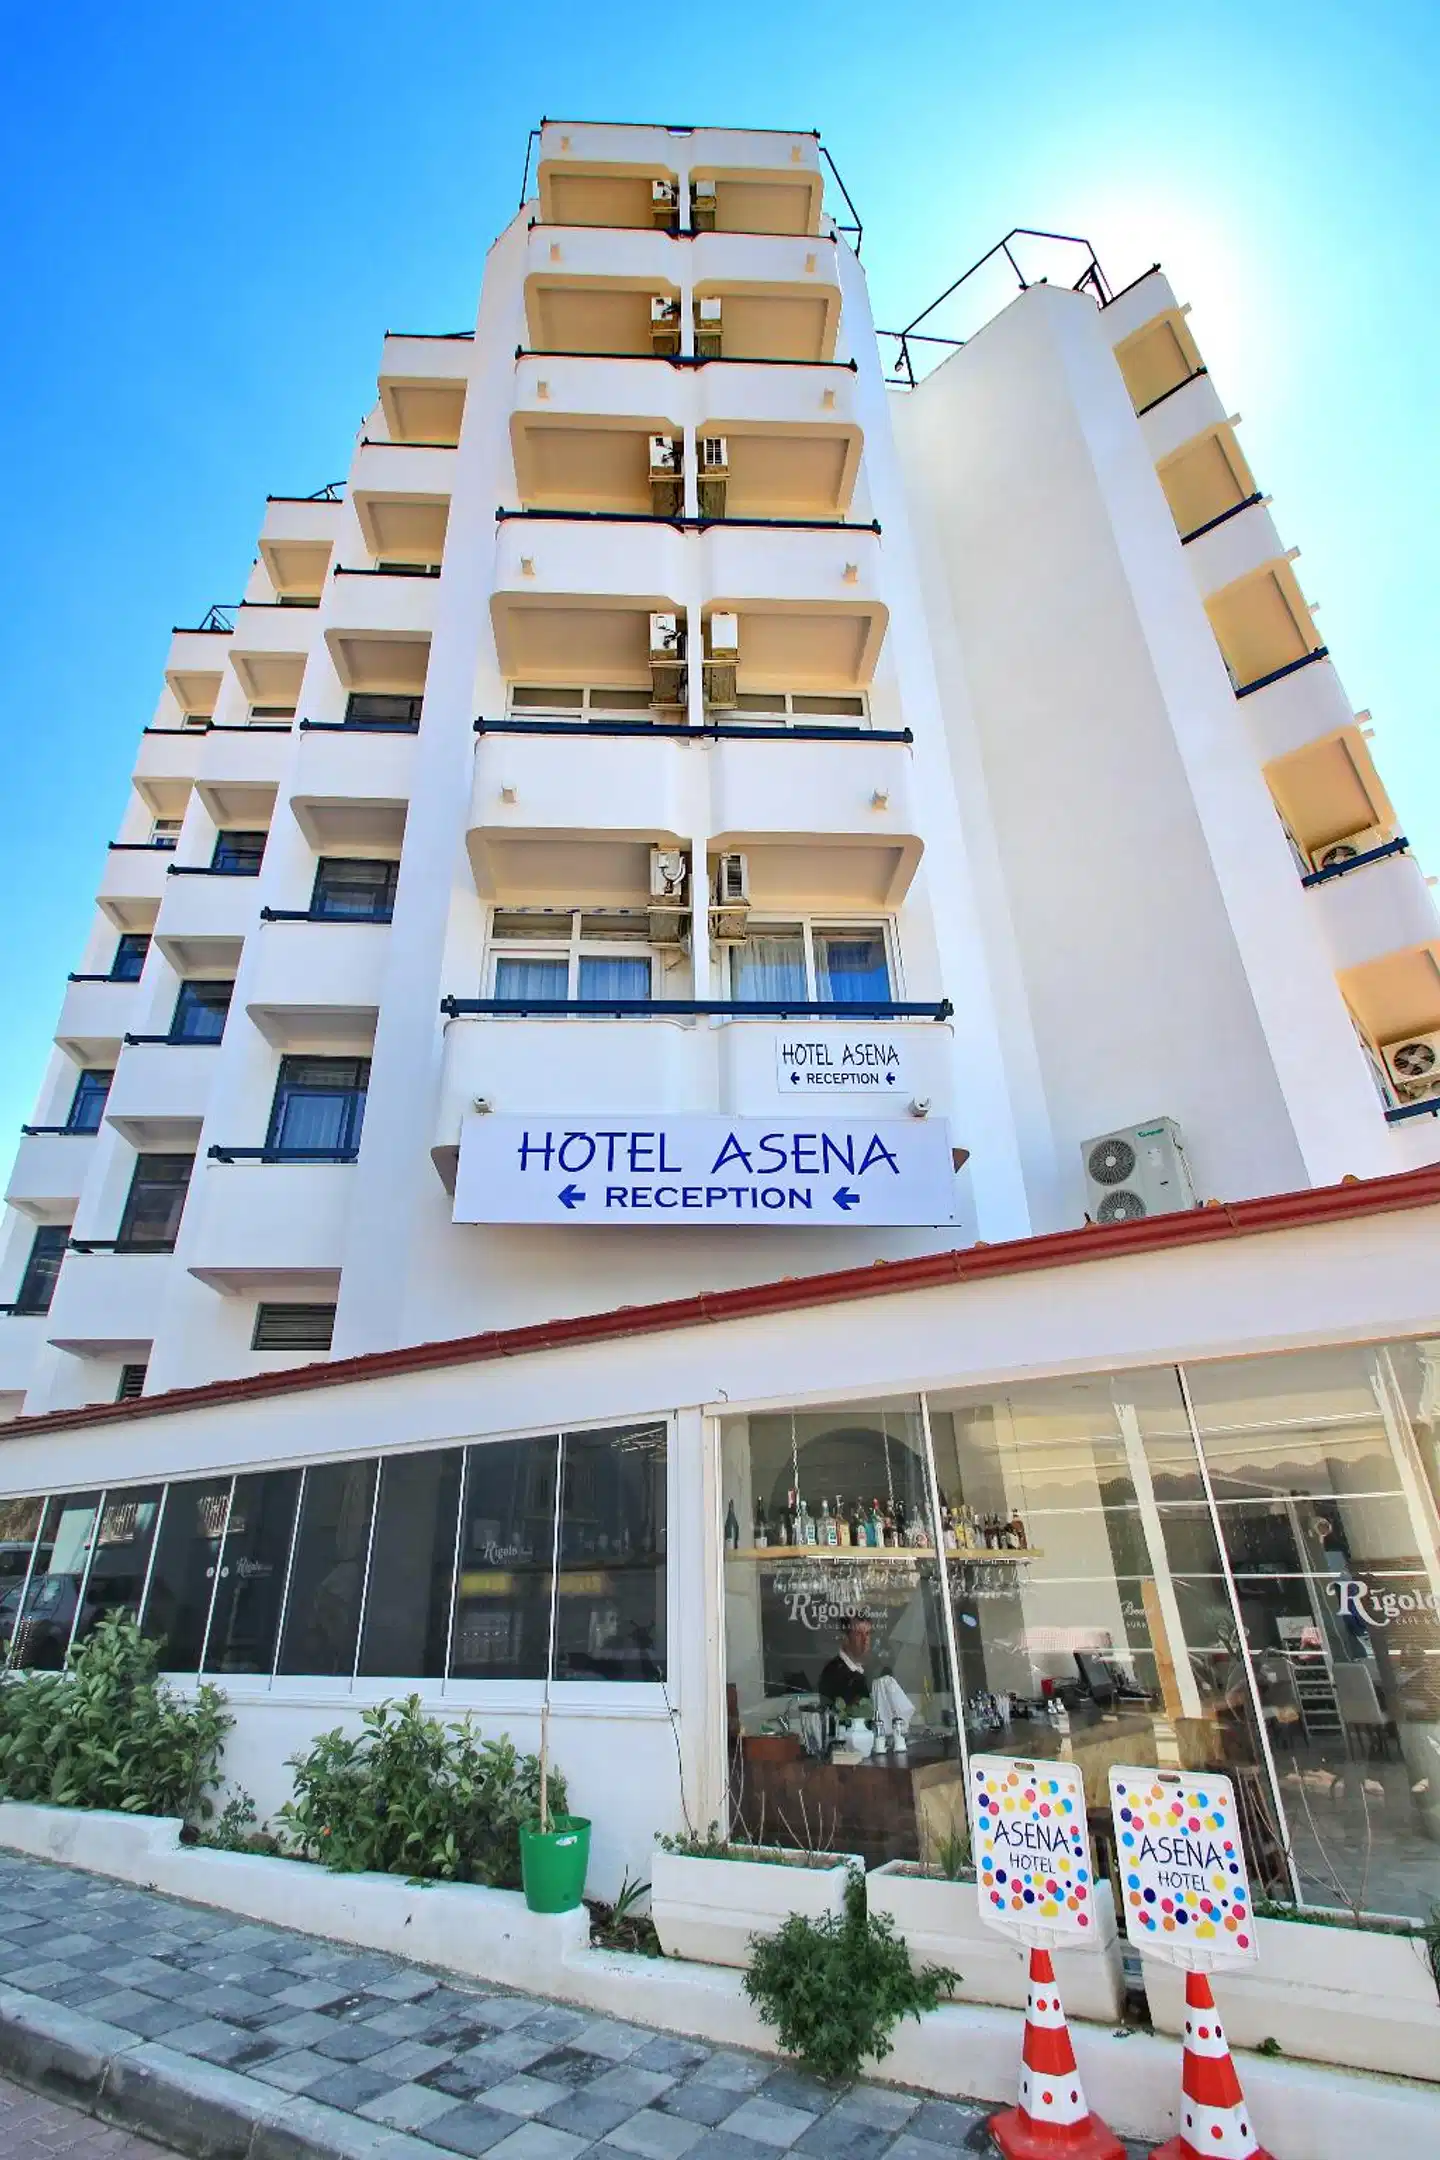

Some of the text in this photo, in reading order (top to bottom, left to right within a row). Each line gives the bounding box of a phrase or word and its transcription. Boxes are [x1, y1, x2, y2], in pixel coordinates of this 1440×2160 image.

[782, 1043, 900, 1066] HOTEL ASENA
[806, 1073, 879, 1084] RECEPTION
[518, 1132, 900, 1175] HOTEL ASENA
[605, 1186, 812, 1209] RECEPTION
[993, 1820, 1070, 1854] ASENA
[1009, 1852, 1056, 1875] HOTEL
[1140, 1834, 1224, 1871] ASENA
[1158, 1871, 1210, 1893] HOTEL
